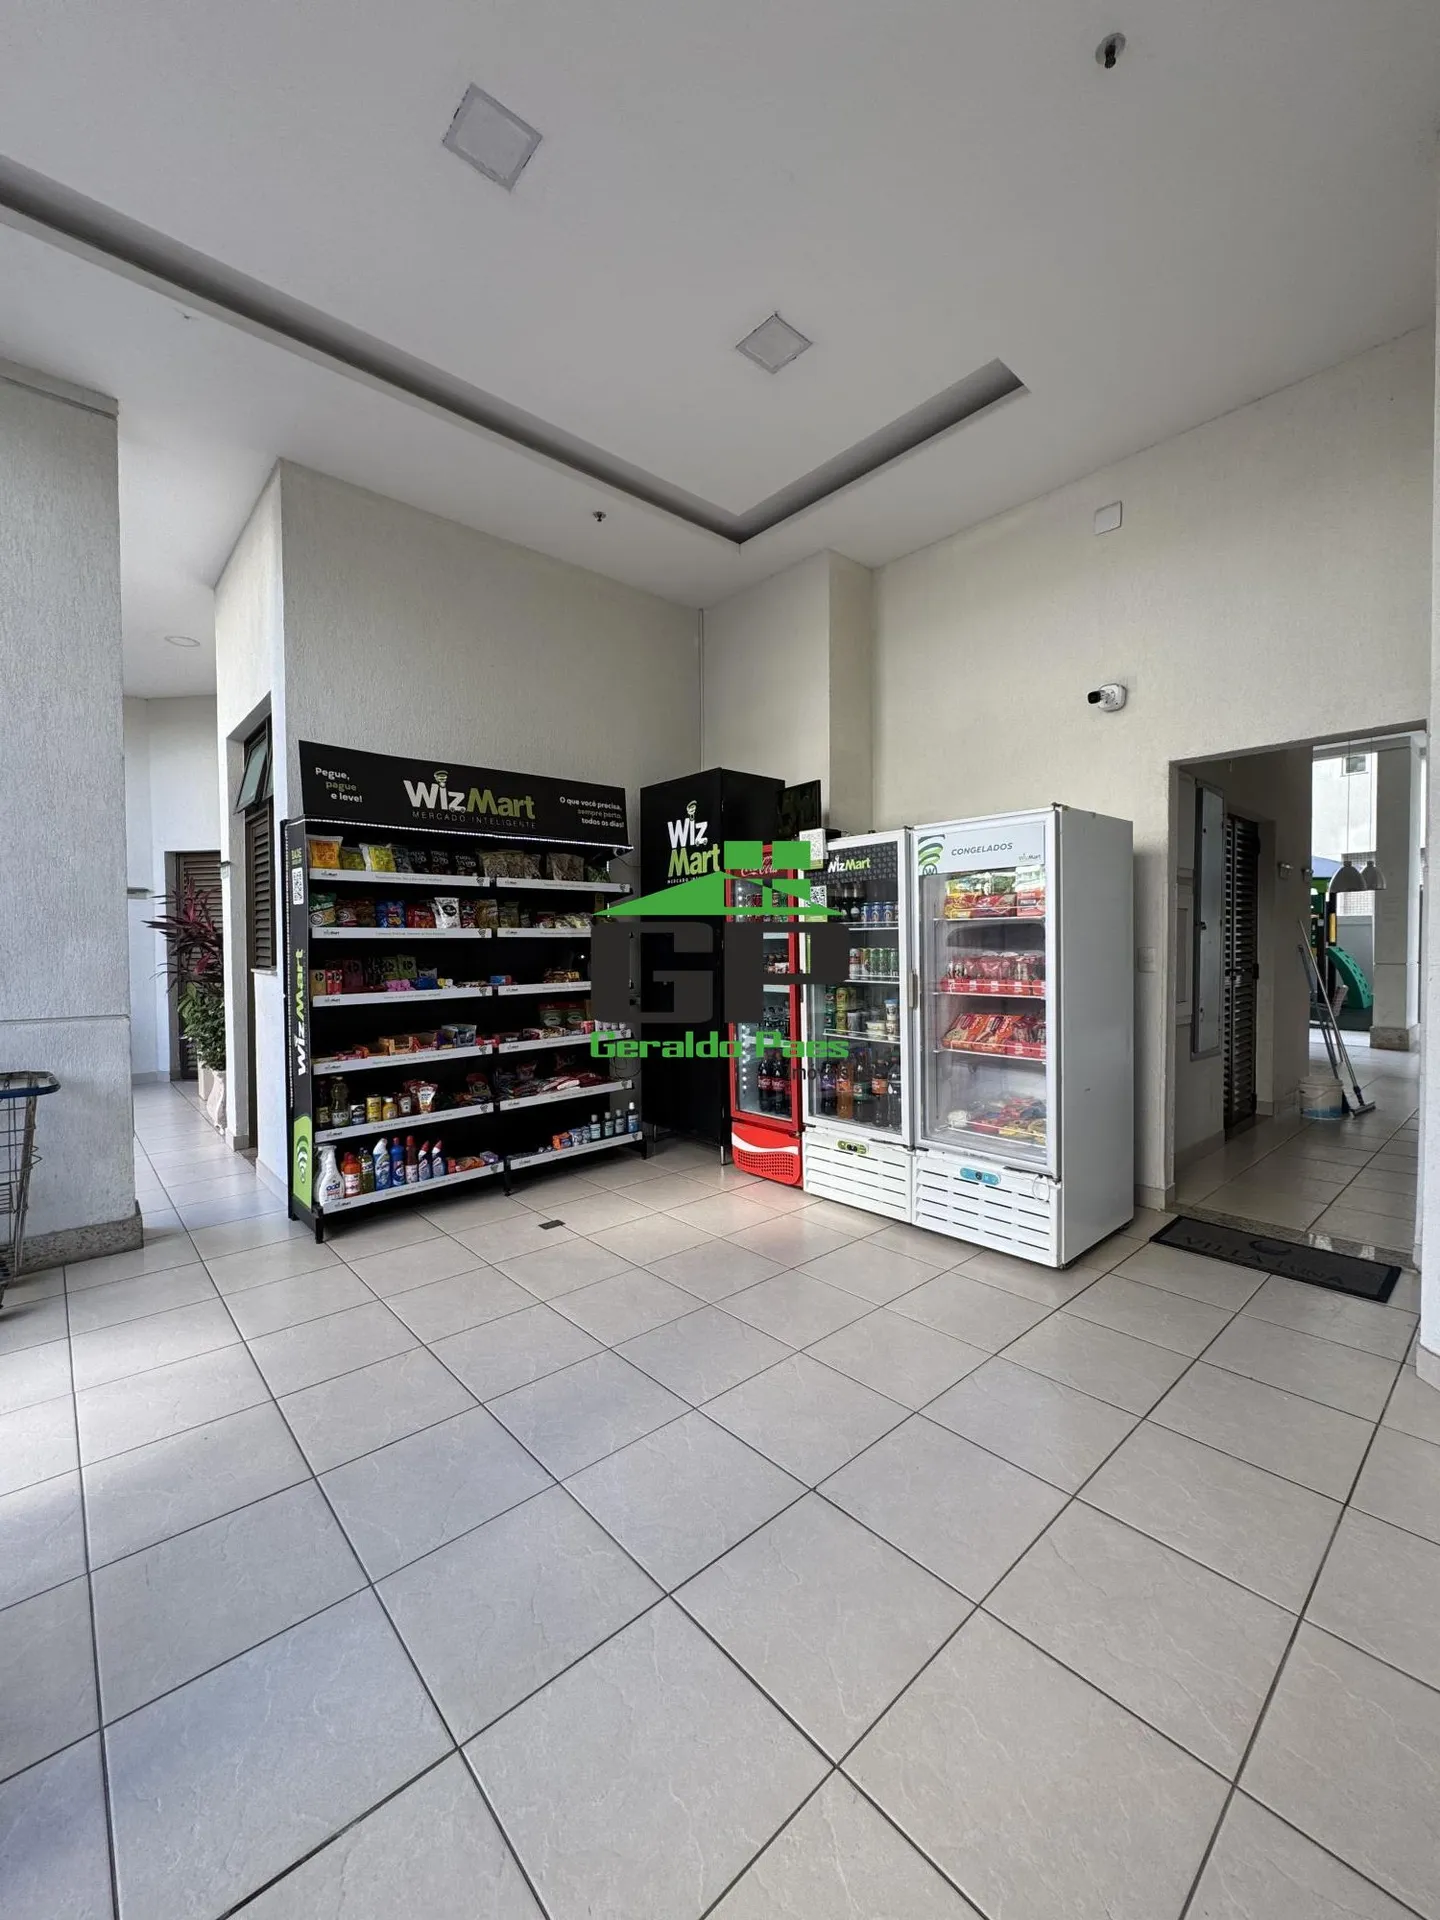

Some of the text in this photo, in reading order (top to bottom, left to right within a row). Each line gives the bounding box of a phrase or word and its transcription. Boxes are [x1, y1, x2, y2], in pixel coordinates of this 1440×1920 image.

[315, 767, 350, 780] Pegue,
[325, 781, 357, 792] pague
[339, 792, 363, 803] leve!
[403, 778, 536, 820] WizMart
[560, 796, 566, 804] O
[567, 798, 580, 806] que
[412, 811, 537, 829] MERCADO INTELIGENTE
[581, 818, 601, 826] todos
[667, 817, 708, 849] Wiz
[951, 842, 1014, 856] CONGELADOS
[668, 844, 721, 877] Mart
